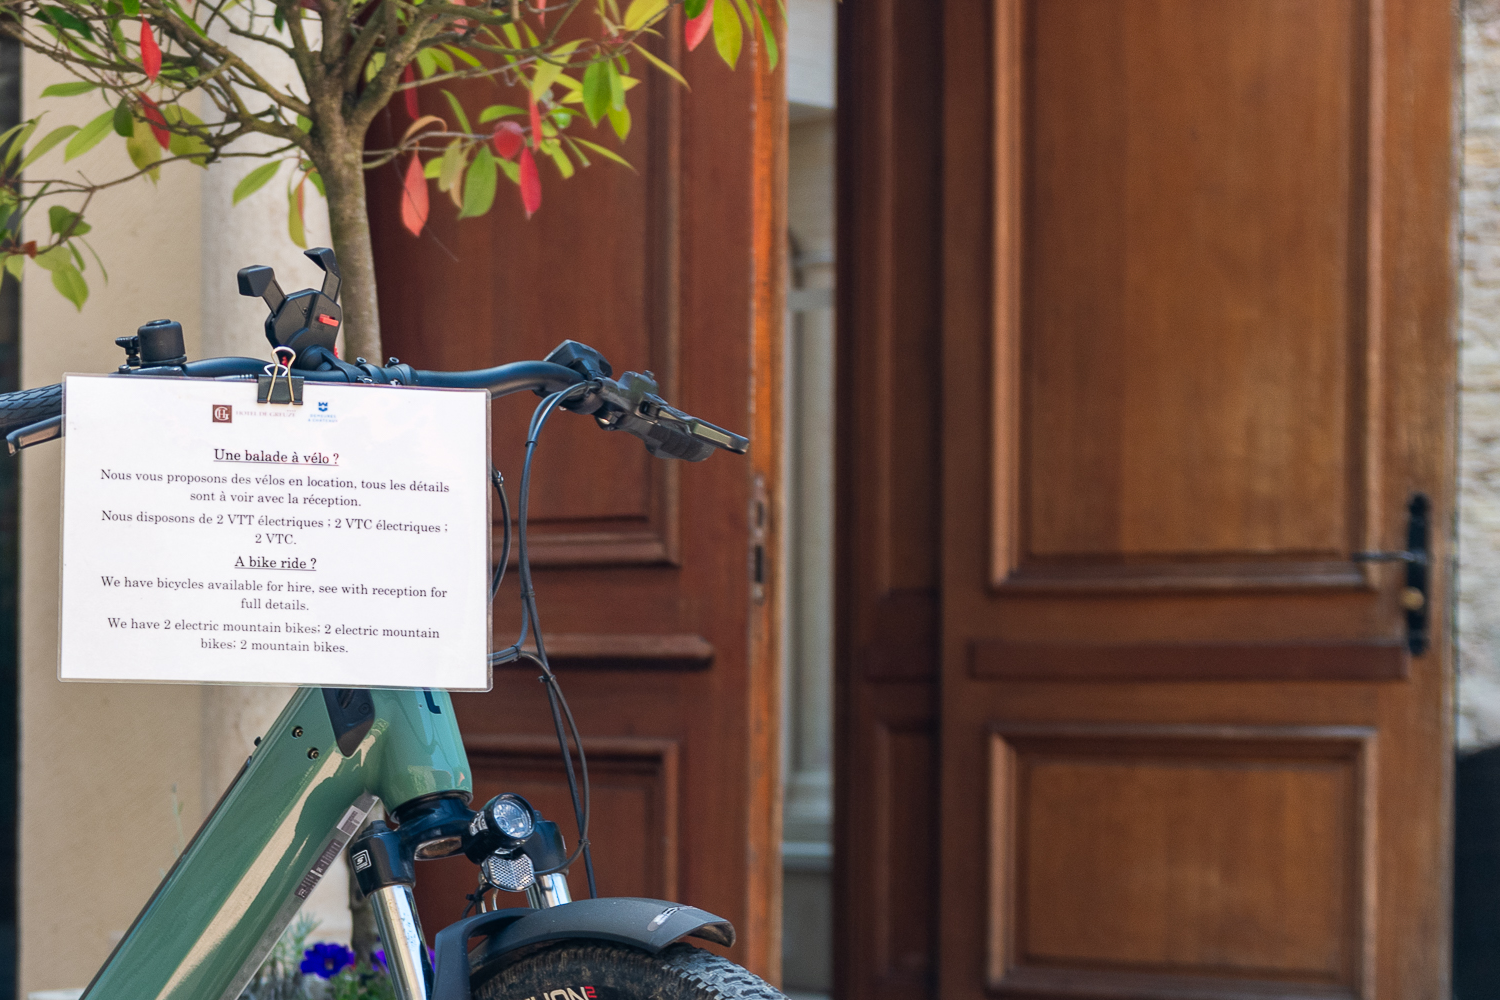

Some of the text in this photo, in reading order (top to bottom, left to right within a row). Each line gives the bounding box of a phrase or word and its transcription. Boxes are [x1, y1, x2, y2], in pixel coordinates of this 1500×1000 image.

[213, 448, 340, 465] Une balade à vélo ?
[100, 468, 450, 493] Nous vous proposons des vélos en location, tous les détails
[189, 490, 362, 508] sont à voir avec la réception.
[101, 509, 133, 522] Nous
[135, 510, 195, 525] disposons
[198, 512, 213, 525] de
[216, 514, 224, 525] 2
[227, 513, 255, 526] VTT
[257, 514, 324, 530] électriques
[334, 518, 342, 529] 2
[345, 517, 373, 530] VTC
[375, 519, 441, 535] électriques
[255, 533, 297, 545] 2 VTC.
[234, 555, 318, 570] A bike ride ?
[100, 575, 448, 599] We have bicycles available for hire, see with reception for
[241, 597, 309, 611] full details.
[107, 617, 128, 629] We
[131, 617, 161, 630] have
[163, 619, 171, 630] 2
[174, 618, 219, 631] electric
[223, 621, 281, 633] mountain
[324, 623, 332, 635] 2
[334, 623, 379, 636] electric
[382, 627, 440, 639] mountain
[240, 639, 247, 650] 2
[251, 640, 310, 652] mountain
[313, 640, 349, 653] bikes.
